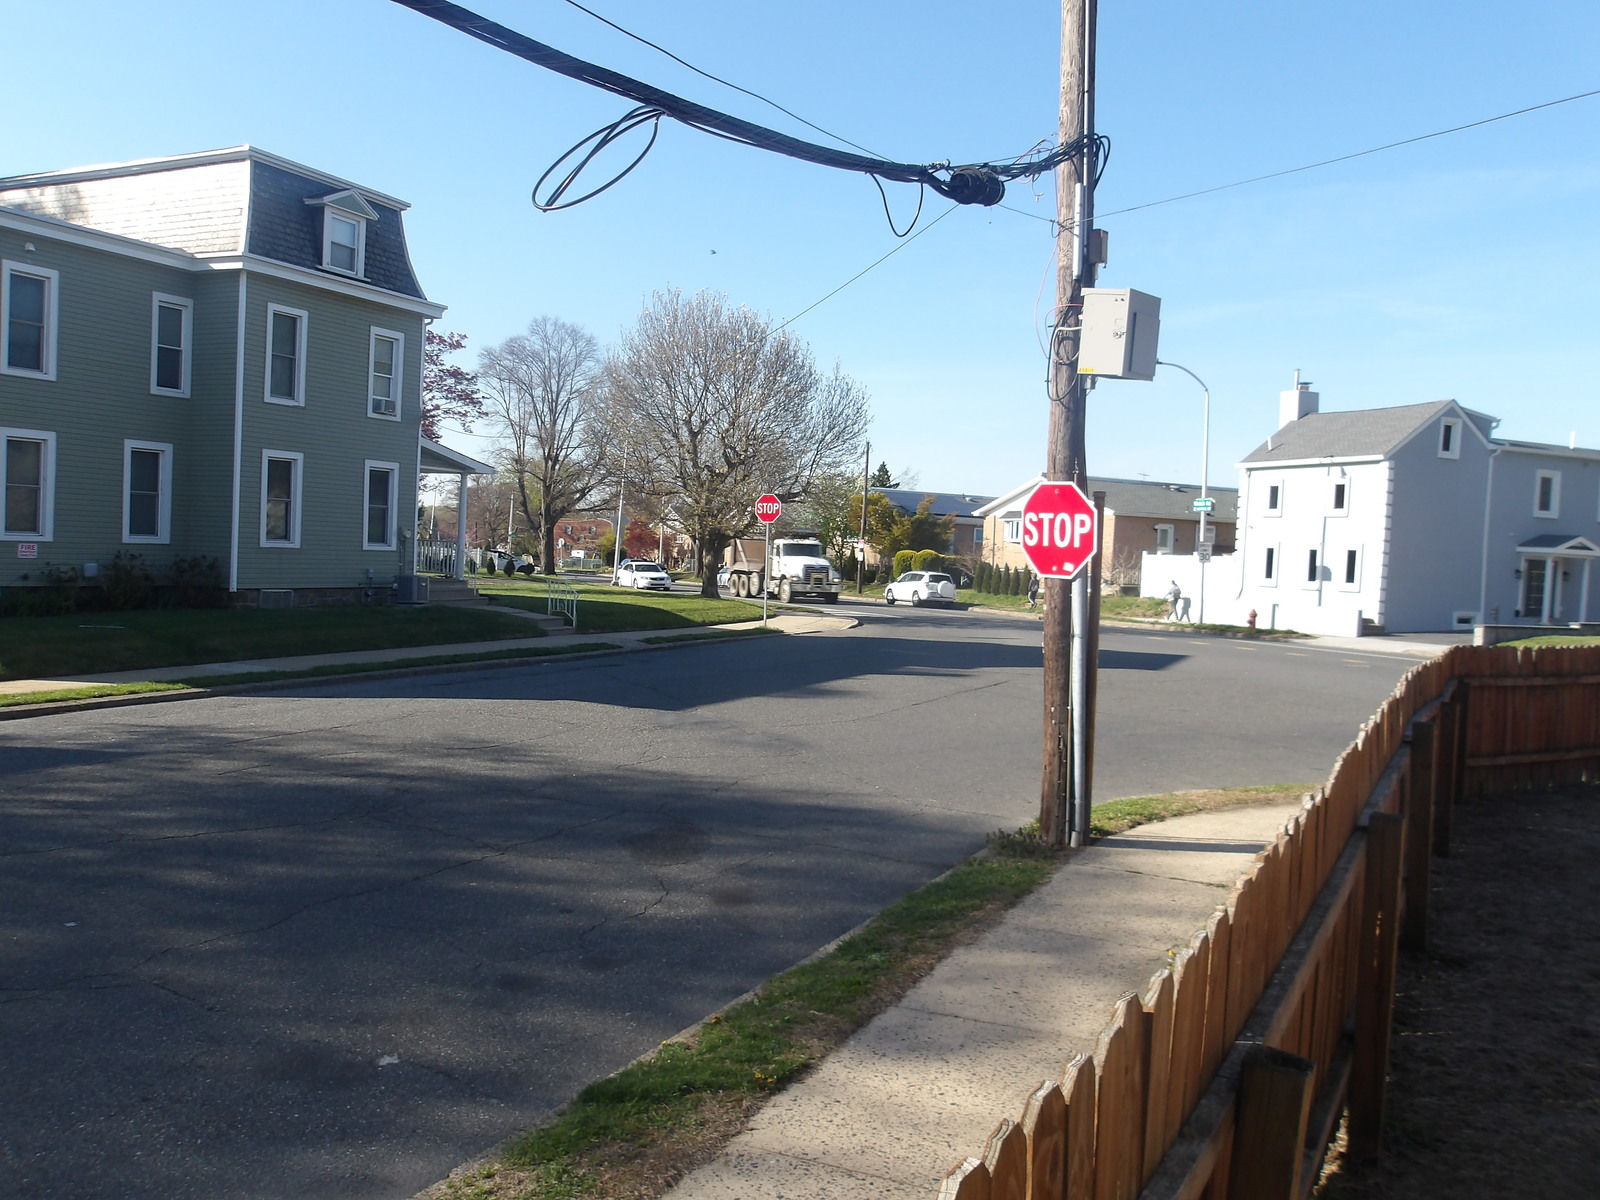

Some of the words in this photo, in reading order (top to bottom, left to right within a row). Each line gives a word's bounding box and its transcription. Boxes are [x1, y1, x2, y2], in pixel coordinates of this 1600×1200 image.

[757, 503, 779, 513] STOP
[1024, 512, 1091, 548] STOP
[1199, 552, 1210, 561] 30
